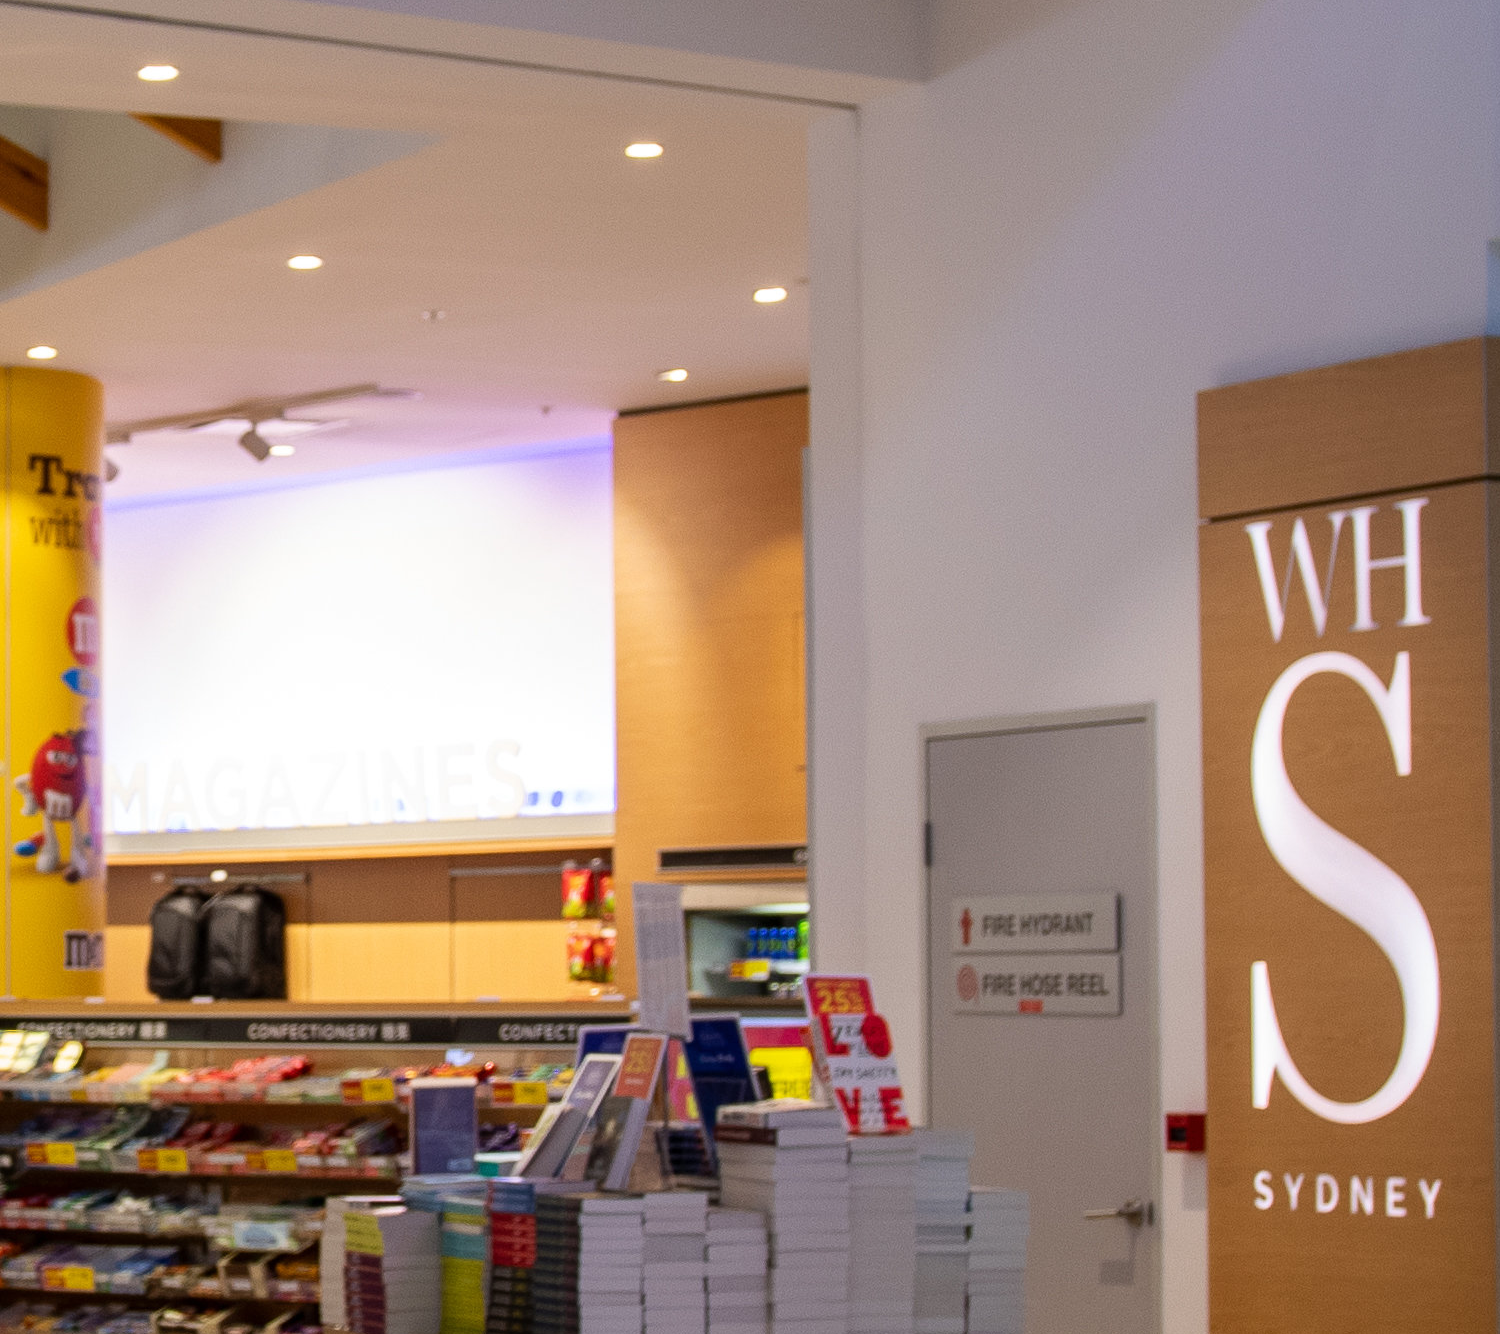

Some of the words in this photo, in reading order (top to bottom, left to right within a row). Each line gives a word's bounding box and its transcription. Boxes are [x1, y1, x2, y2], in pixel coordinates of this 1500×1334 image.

[1244, 497, 1432, 644] WH
[107, 739, 527, 833] MAGAZINES
[1251, 650, 1440, 1125] S
[982, 914, 1016, 937] FIRE
[1019, 911, 1094, 936] HYDRANT
[982, 973, 1017, 997] FIRE
[1019, 973, 1064, 997] HOSE
[1066, 972, 1110, 997] REEL
[247, 1021, 378, 1041] CONFECTIONERY
[1252, 1171, 1444, 1219] SYDNEY
